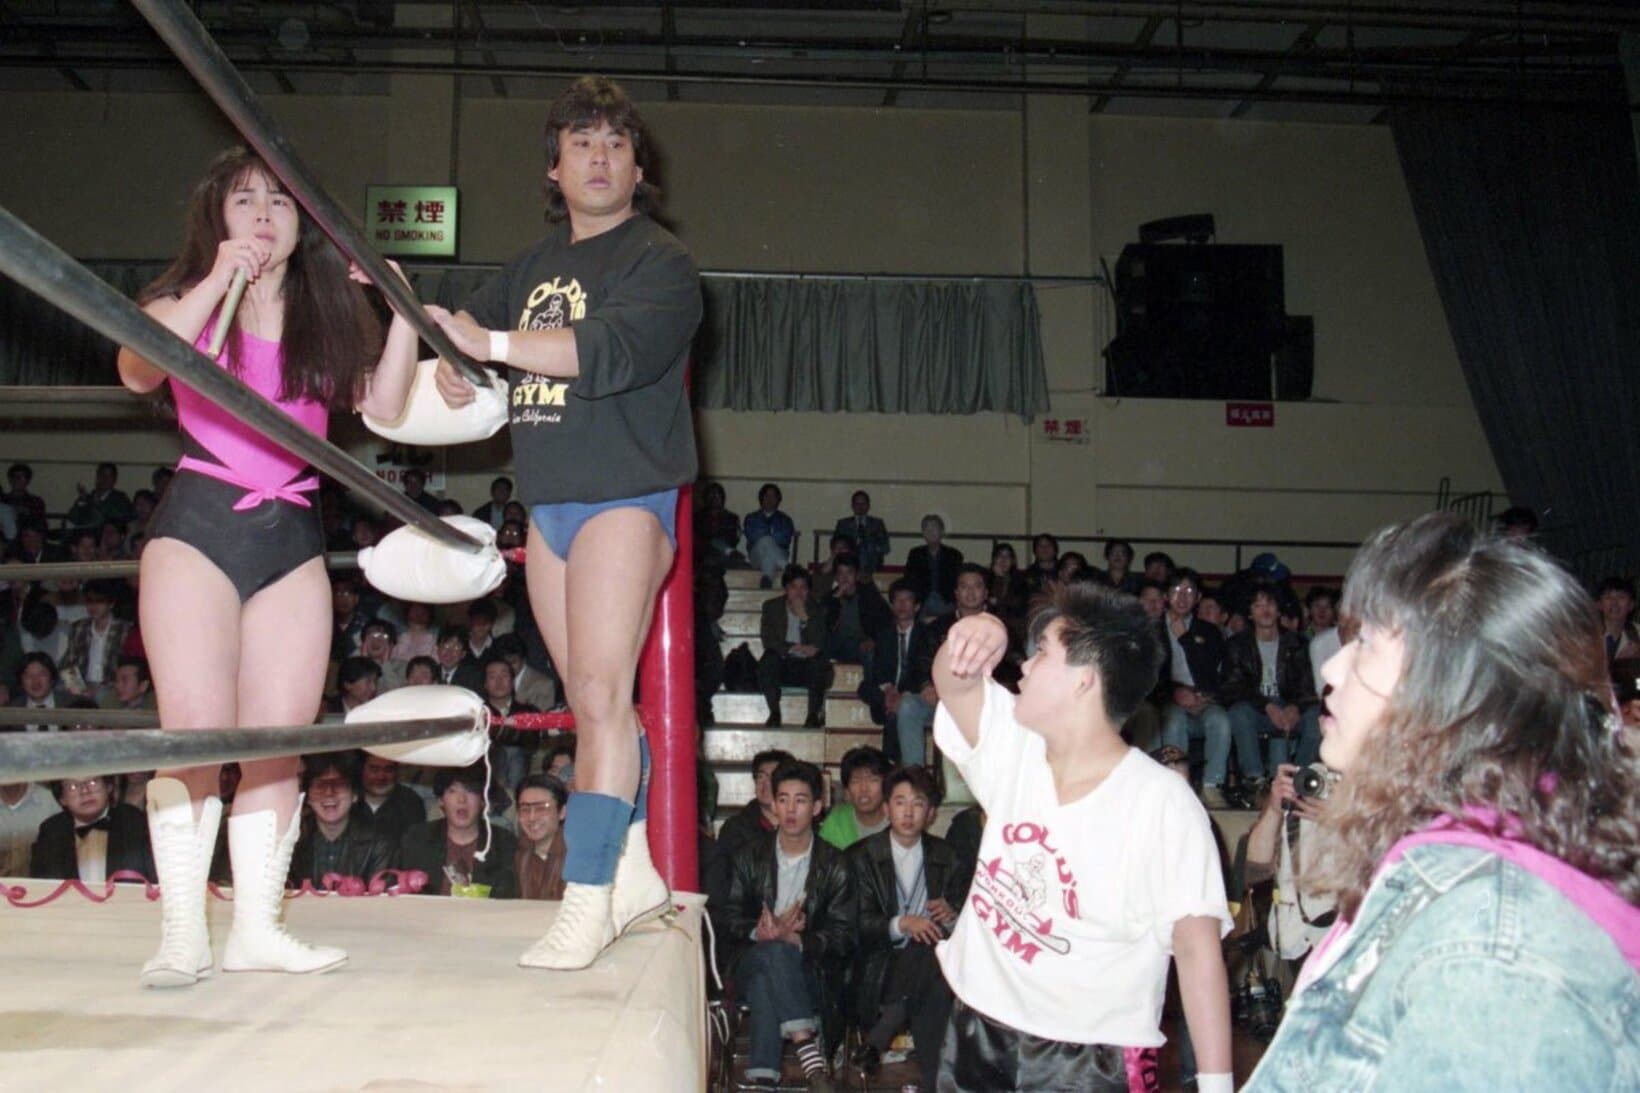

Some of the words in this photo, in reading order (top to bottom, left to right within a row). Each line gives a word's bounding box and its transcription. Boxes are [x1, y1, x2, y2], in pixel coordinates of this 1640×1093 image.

[377, 200, 445, 223] 禁煙
[376, 229, 391, 241] NO
[394, 229, 444, 242] SMOKING
[513, 383, 568, 406] GYM
[971, 893, 1042, 965] GYM
